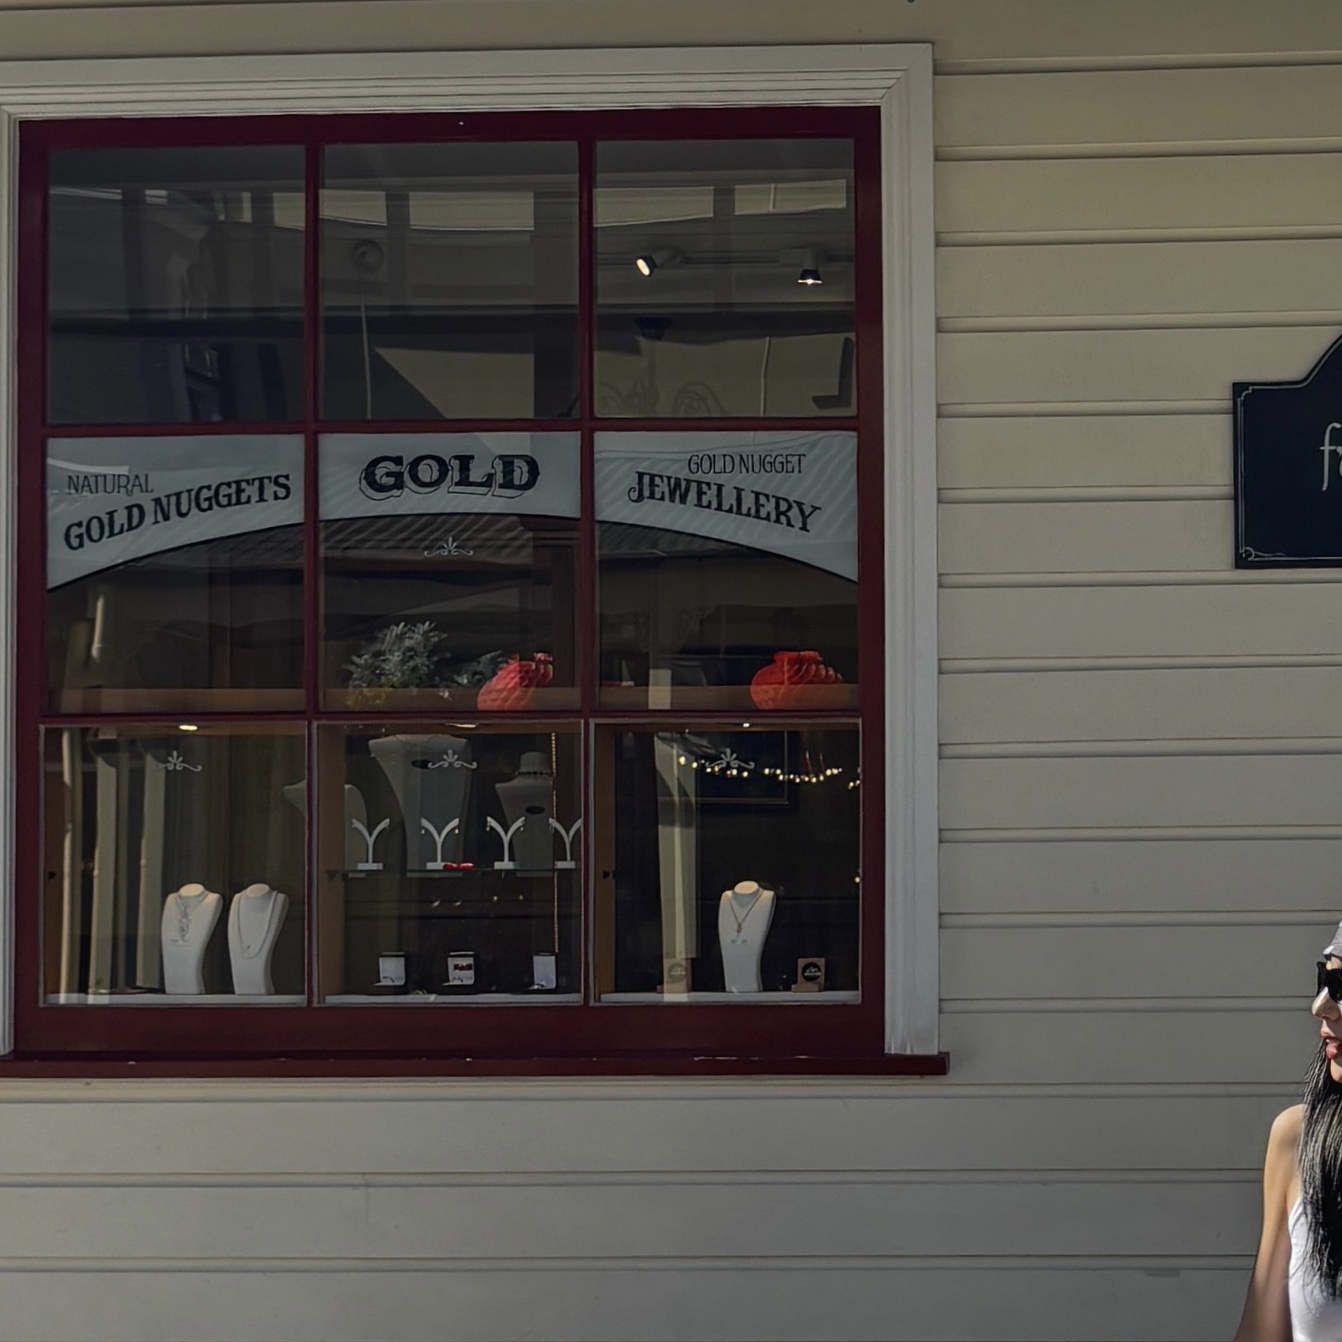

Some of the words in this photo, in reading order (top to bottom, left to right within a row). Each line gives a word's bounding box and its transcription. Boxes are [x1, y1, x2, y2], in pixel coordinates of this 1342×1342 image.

[67, 473, 154, 496] NATURAL
[358, 454, 541, 501] GOLD
[688, 453, 735, 475] GOLD
[738, 453, 807, 475] NUGGET
[63, 503, 146, 551] GOLD
[150, 474, 292, 525] NUGGETS
[627, 470, 822, 533] JEWELLERY
